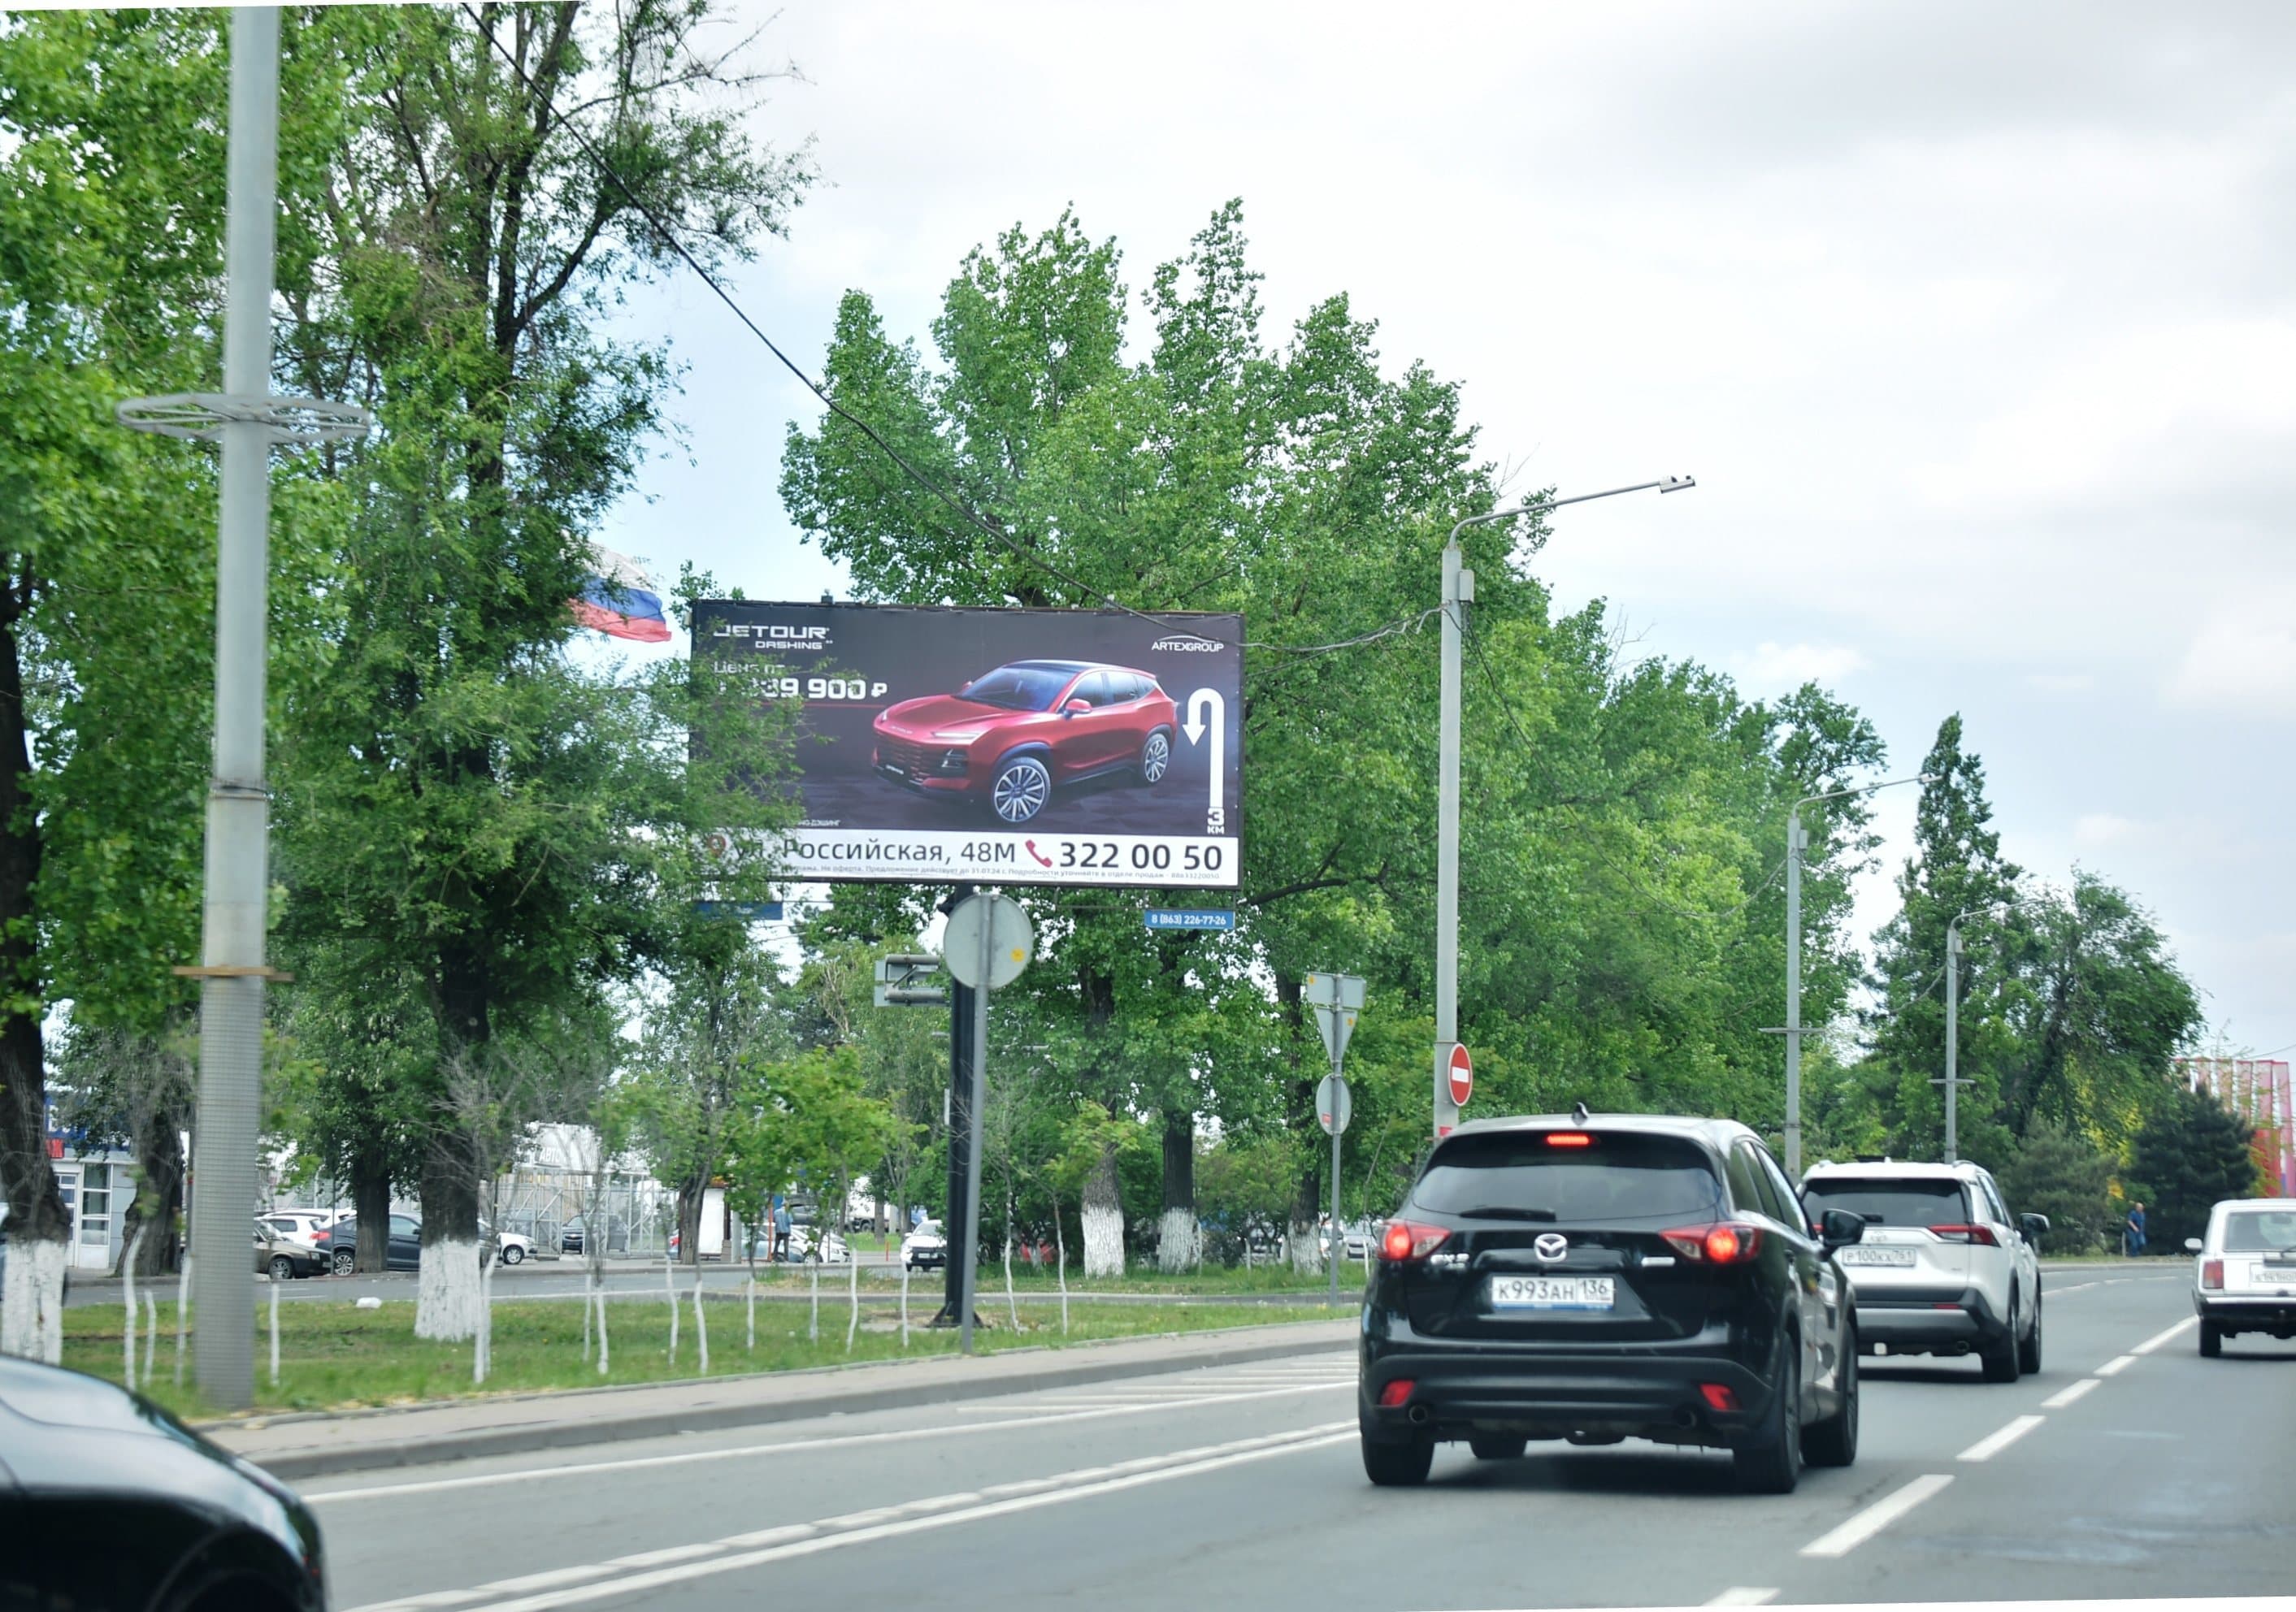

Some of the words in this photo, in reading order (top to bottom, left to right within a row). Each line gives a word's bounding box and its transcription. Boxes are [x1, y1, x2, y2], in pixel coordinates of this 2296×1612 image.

[1151, 641, 1224, 652] ARTEXGROUP
[807, 678, 866, 700] 900
[1207, 808, 1225, 826] 3
[783, 838, 951, 865] Российская,
[961, 842, 1015, 863] 48М
[1059, 842, 1118, 868] 322
[1131, 843, 1170, 869] 00
[1184, 845, 1222, 871] 50
[1152, 915, 1157, 923] 8
[1160, 914, 1182, 924] (863)
[1184, 915, 1226, 925] 226-77-26
[1581, 1280, 1608, 1294] 136
